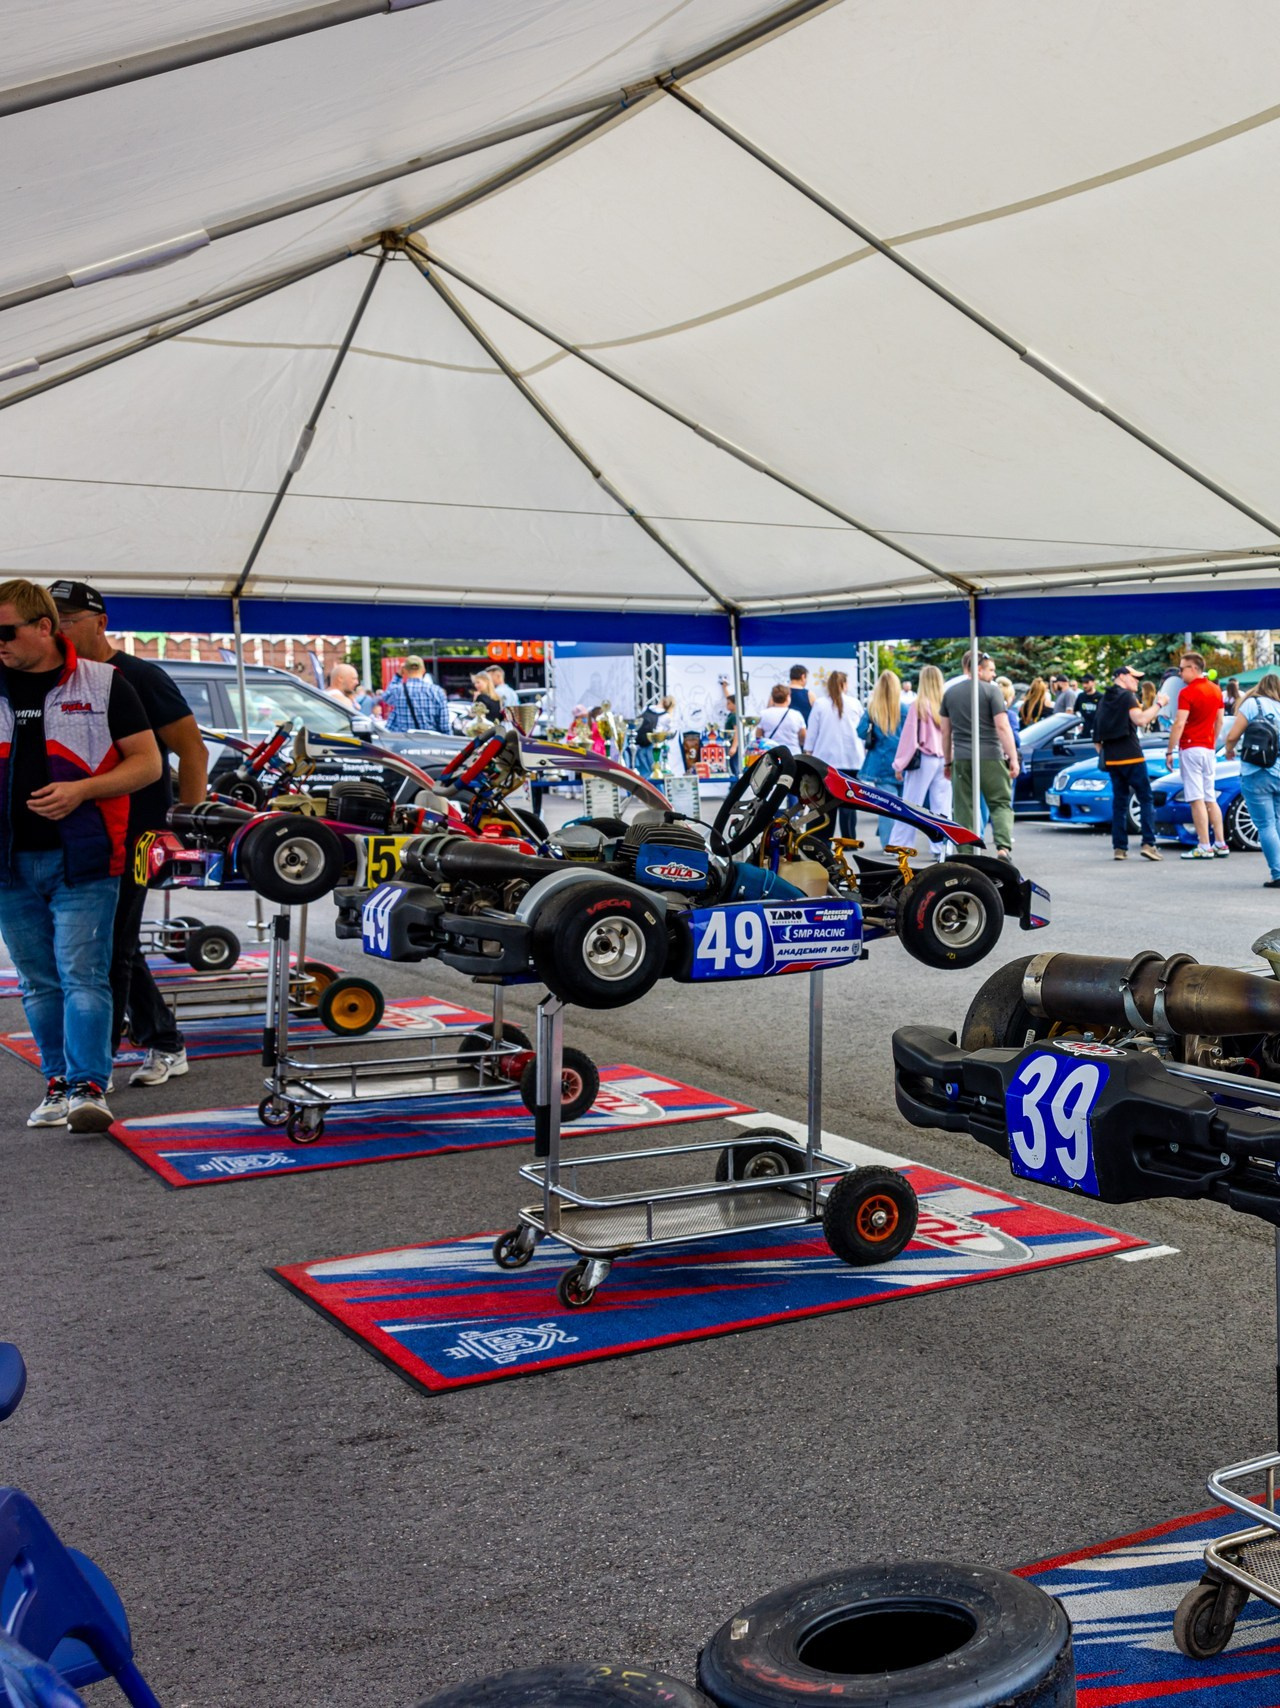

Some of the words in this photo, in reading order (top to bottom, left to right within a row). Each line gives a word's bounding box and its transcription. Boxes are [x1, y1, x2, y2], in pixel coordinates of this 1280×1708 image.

[858, 789, 890, 804] АКАДЕМИЯ
[890, 802, 902, 811] РАФ
[136, 833, 154, 881] 50
[660, 867, 693, 878] TULA
[363, 887, 402, 952] 49
[587, 898, 631, 916] VEGA
[916, 891, 936, 930] VEGA
[697, 911, 763, 970] 49
[793, 929, 813, 938] SMP
[814, 928, 846, 937] RACING
[777, 946, 828, 956] АКАДЕМИЯ
[1012, 1054, 1100, 1181] 39
